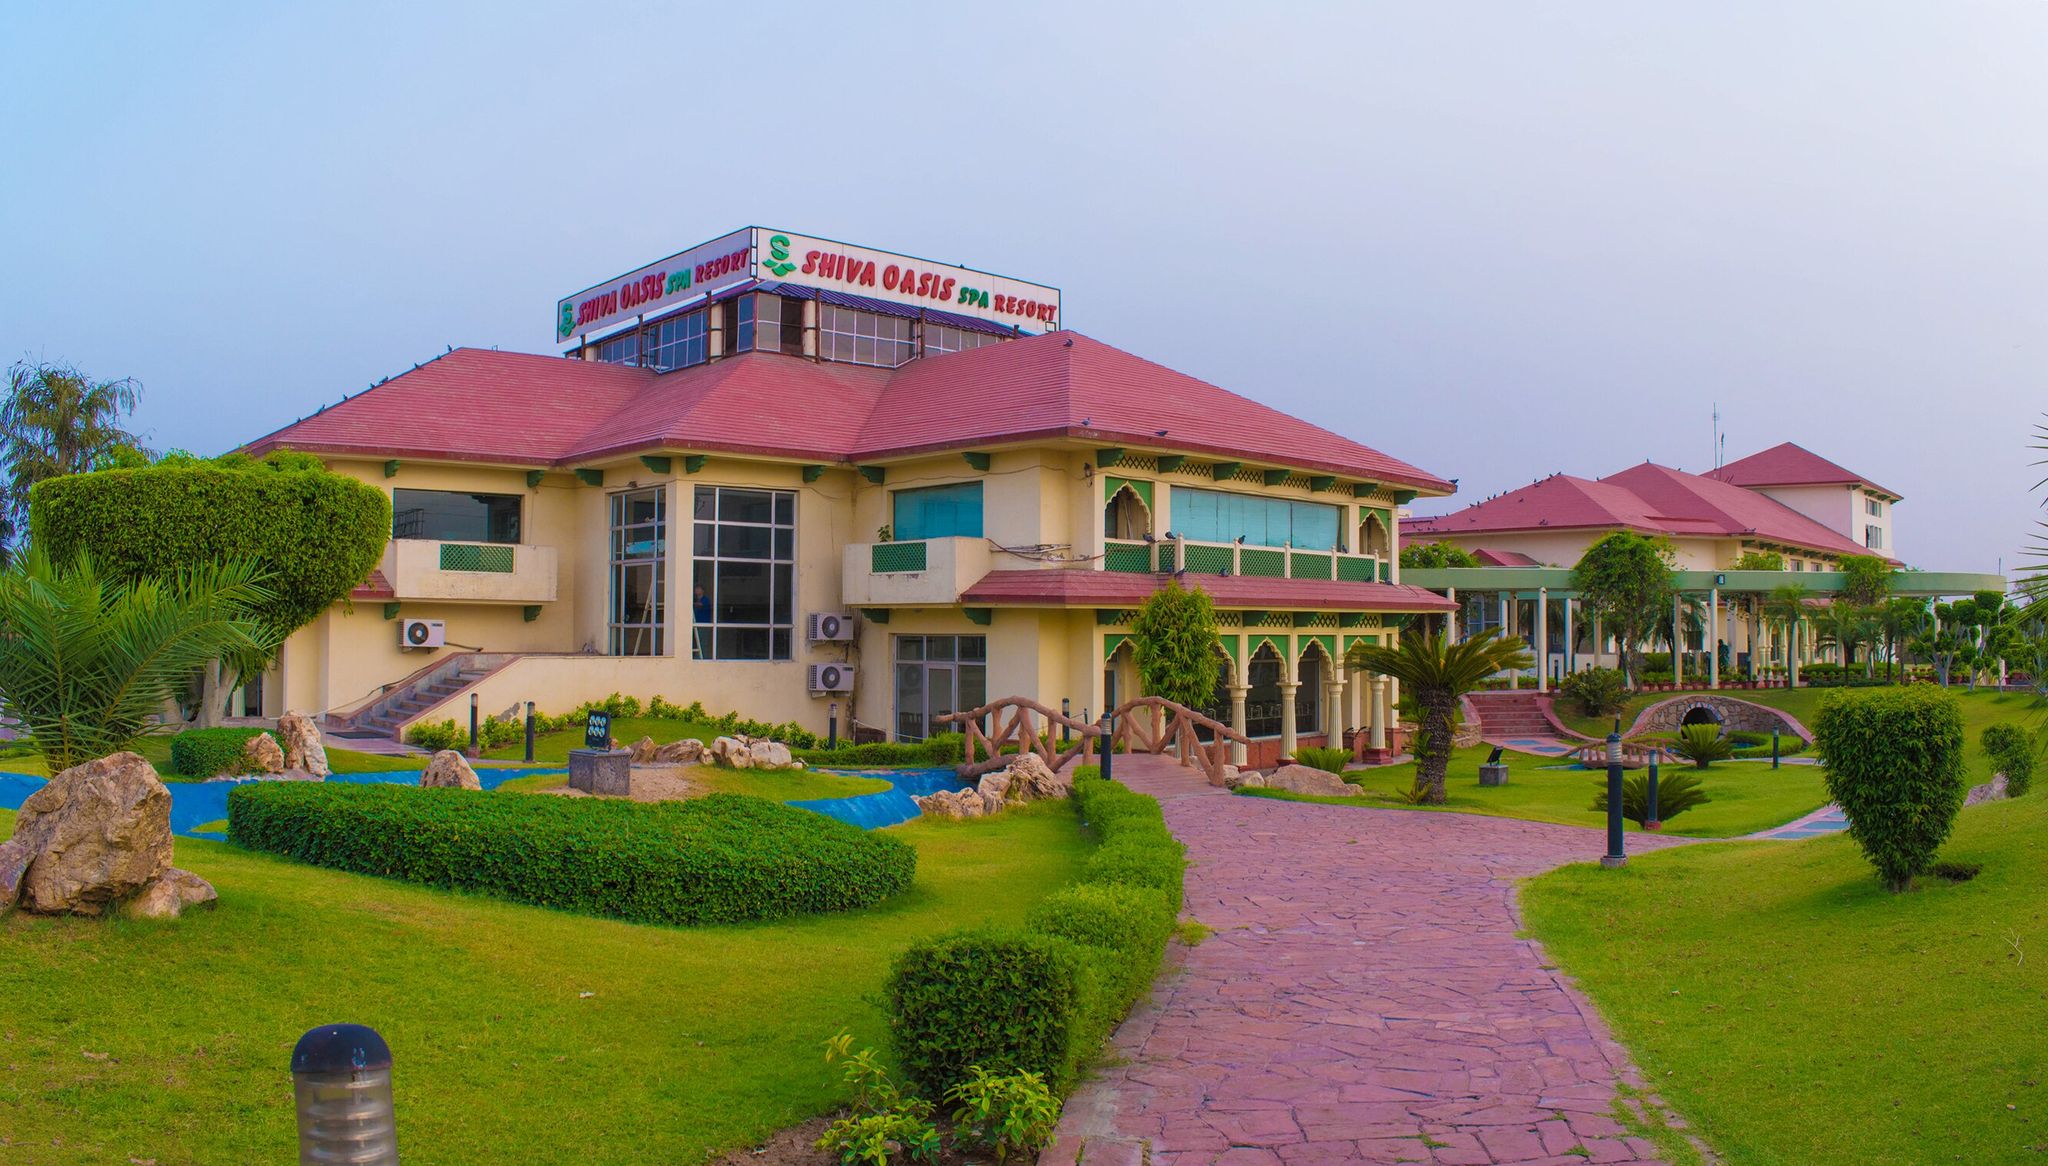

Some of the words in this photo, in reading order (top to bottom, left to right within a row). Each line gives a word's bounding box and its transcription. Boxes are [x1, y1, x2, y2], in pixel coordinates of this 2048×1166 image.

[577, 290, 617, 326] SHIVA
[620, 272, 666, 310] OASIS
[665, 267, 692, 295] SPA
[694, 248, 749, 283] RESORT
[802, 250, 875, 287] SHIVA
[882, 265, 956, 301] OASIS
[957, 286, 989, 308] SPA
[994, 294, 1057, 321] RESORT
